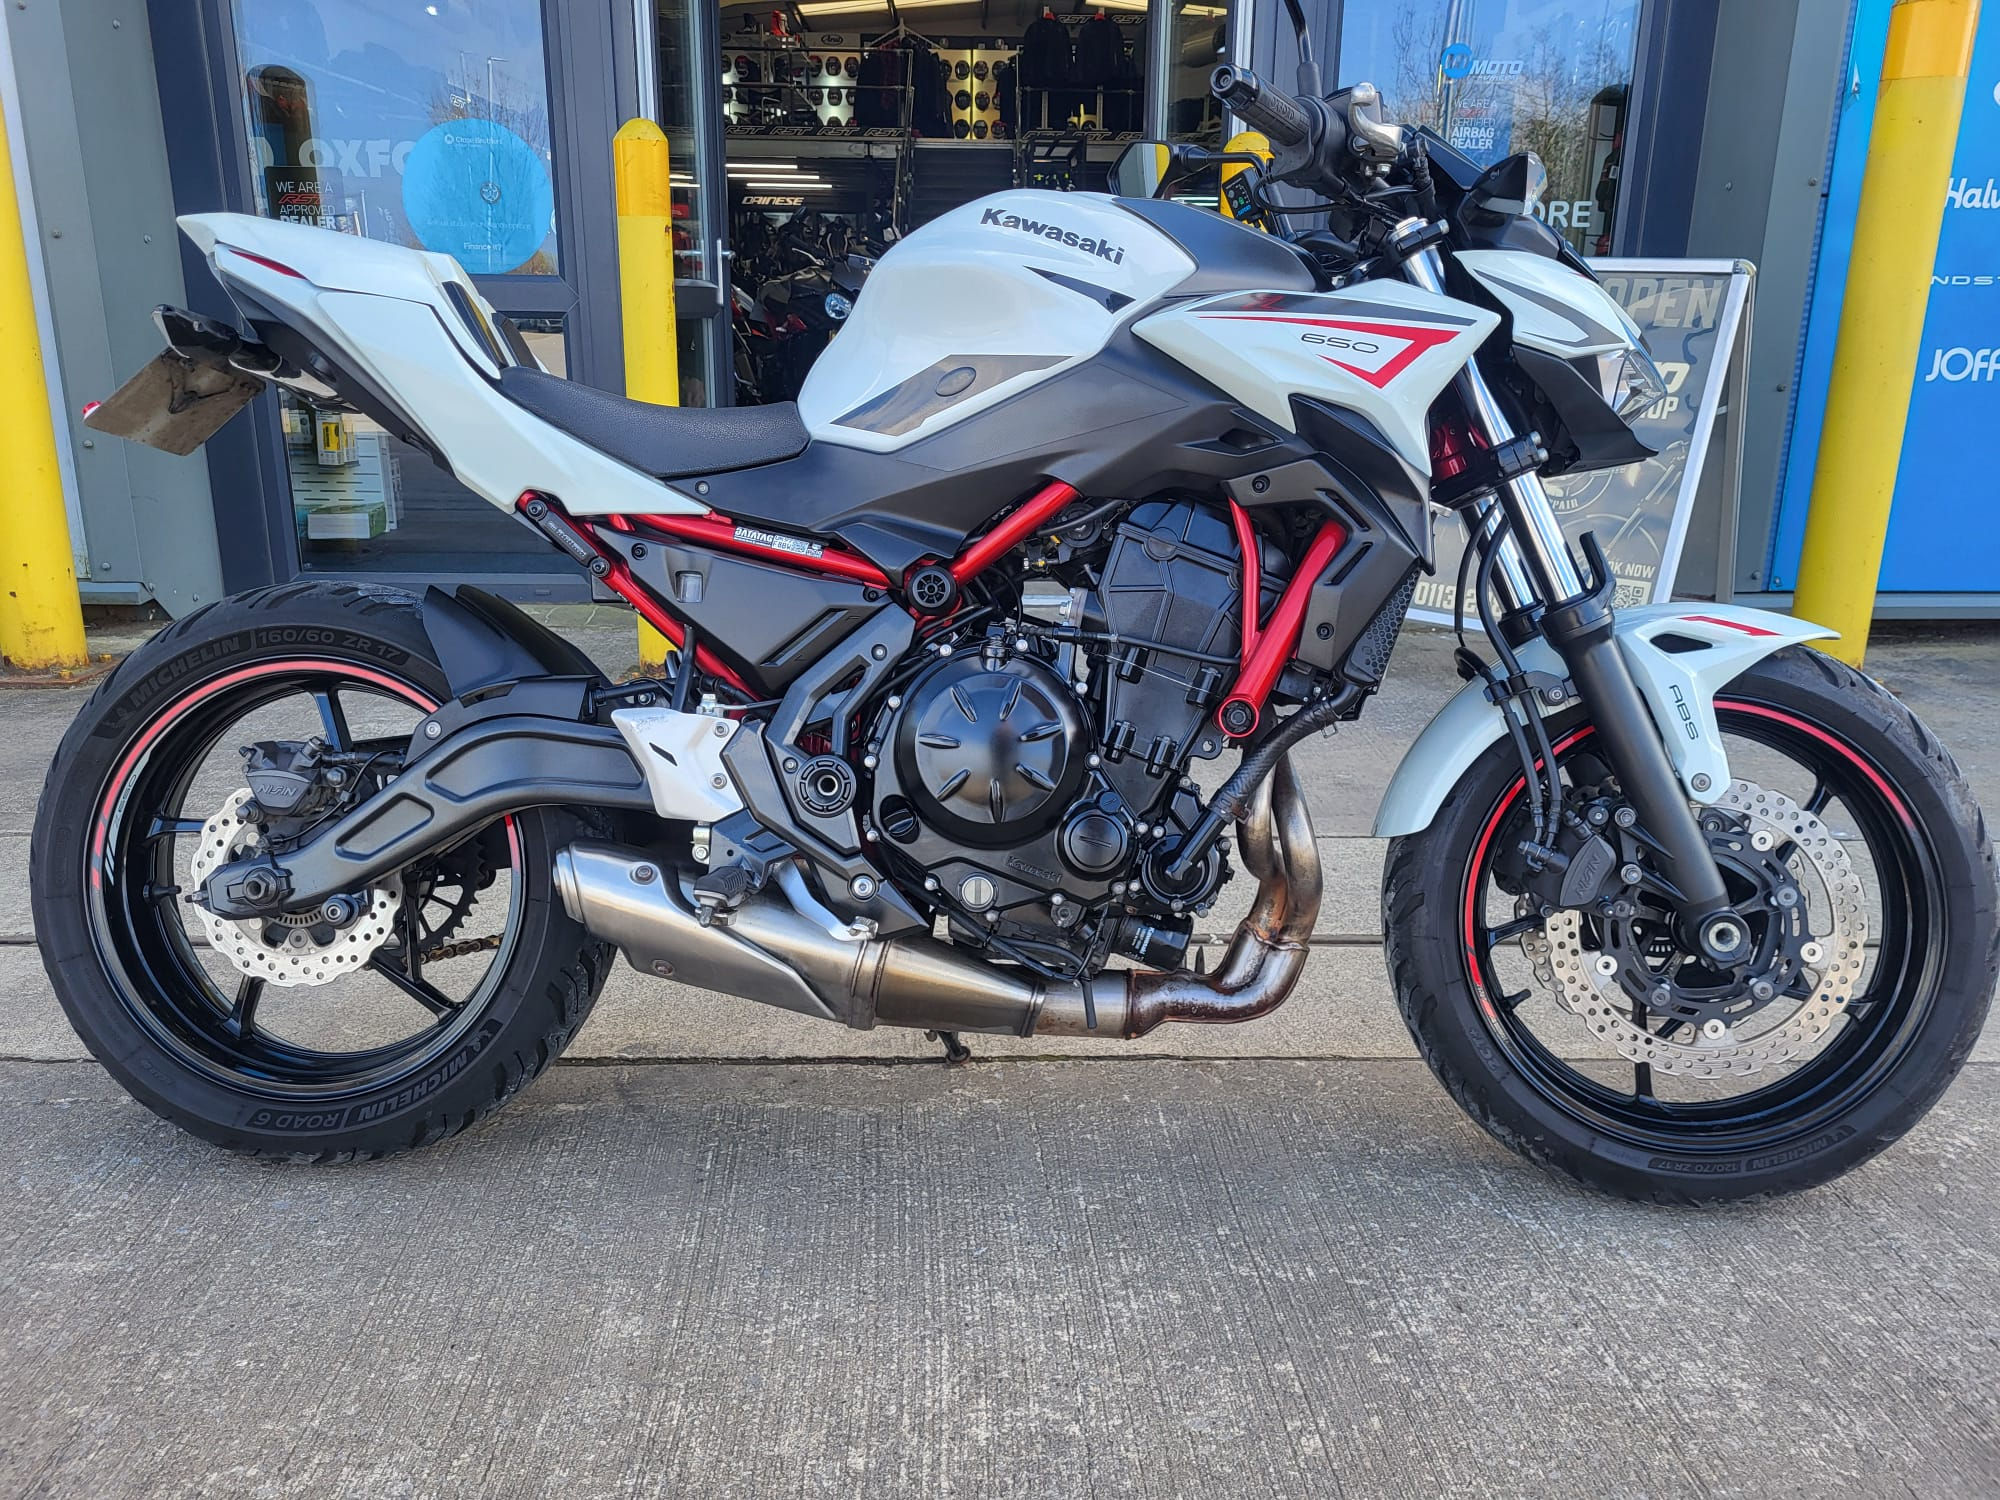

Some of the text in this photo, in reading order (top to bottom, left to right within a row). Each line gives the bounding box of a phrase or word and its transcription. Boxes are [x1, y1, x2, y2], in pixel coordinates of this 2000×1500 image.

[1056, 14, 1097, 24] RST
[1469, 60, 1524, 76] MOTO
[1451, 117, 1496, 127] CERTIFIED
[725, 126, 766, 135] RST
[769, 126, 813, 136] RST
[816, 126, 860, 136] RST
[864, 127, 905, 137] RST
[1451, 127, 1495, 138] AIRBAG
[1451, 138, 1493, 150] DEALER
[275, 181, 334, 193] WE ARE A
[741, 196, 805, 206] DAINESE
[280, 204, 336, 216] APPROVED
[979, 208, 1126, 266] Kawasaki
[1930, 276, 2000, 286] NDS
[1301, 333, 1380, 354] 650
[1551, 498, 1579, 510] PAIR
[1624, 562, 1656, 579] NOW
[1414, 581, 1457, 610] 0113
[130, 628, 401, 707] MICHELIN 160/60 ZR 17
[1668, 684, 1699, 740] ABS
[254, 1050, 469, 1129] MICHELIN ROAD 6
[1752, 1135, 1829, 1170] MICHELIN
[1695, 1162, 1739, 1173] 120/70
